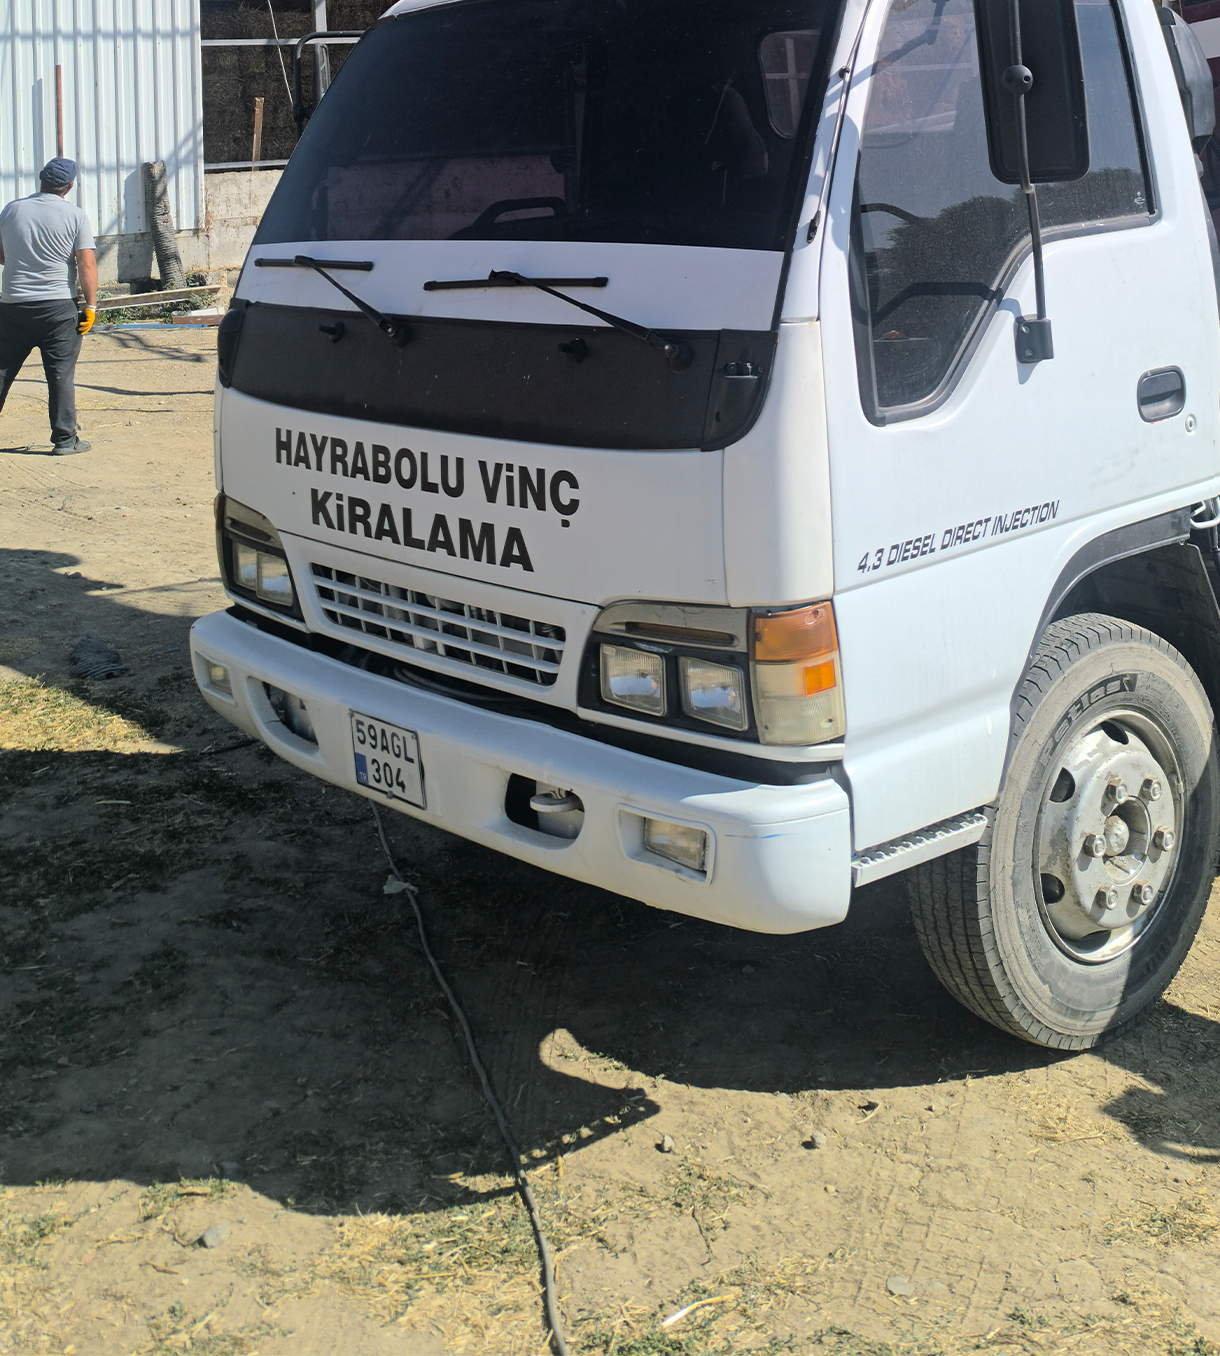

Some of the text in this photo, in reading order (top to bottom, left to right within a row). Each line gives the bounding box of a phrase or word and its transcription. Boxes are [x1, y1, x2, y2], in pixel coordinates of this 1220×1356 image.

[275, 427, 465, 498] HAYRABOLU
[856, 499, 1061, 574] 4.3 DIESEL DIRECT INJECTION
[355, 718, 415, 764] 59AGL
[359, 771, 368, 783] TR
[371, 758, 406, 794] 304
